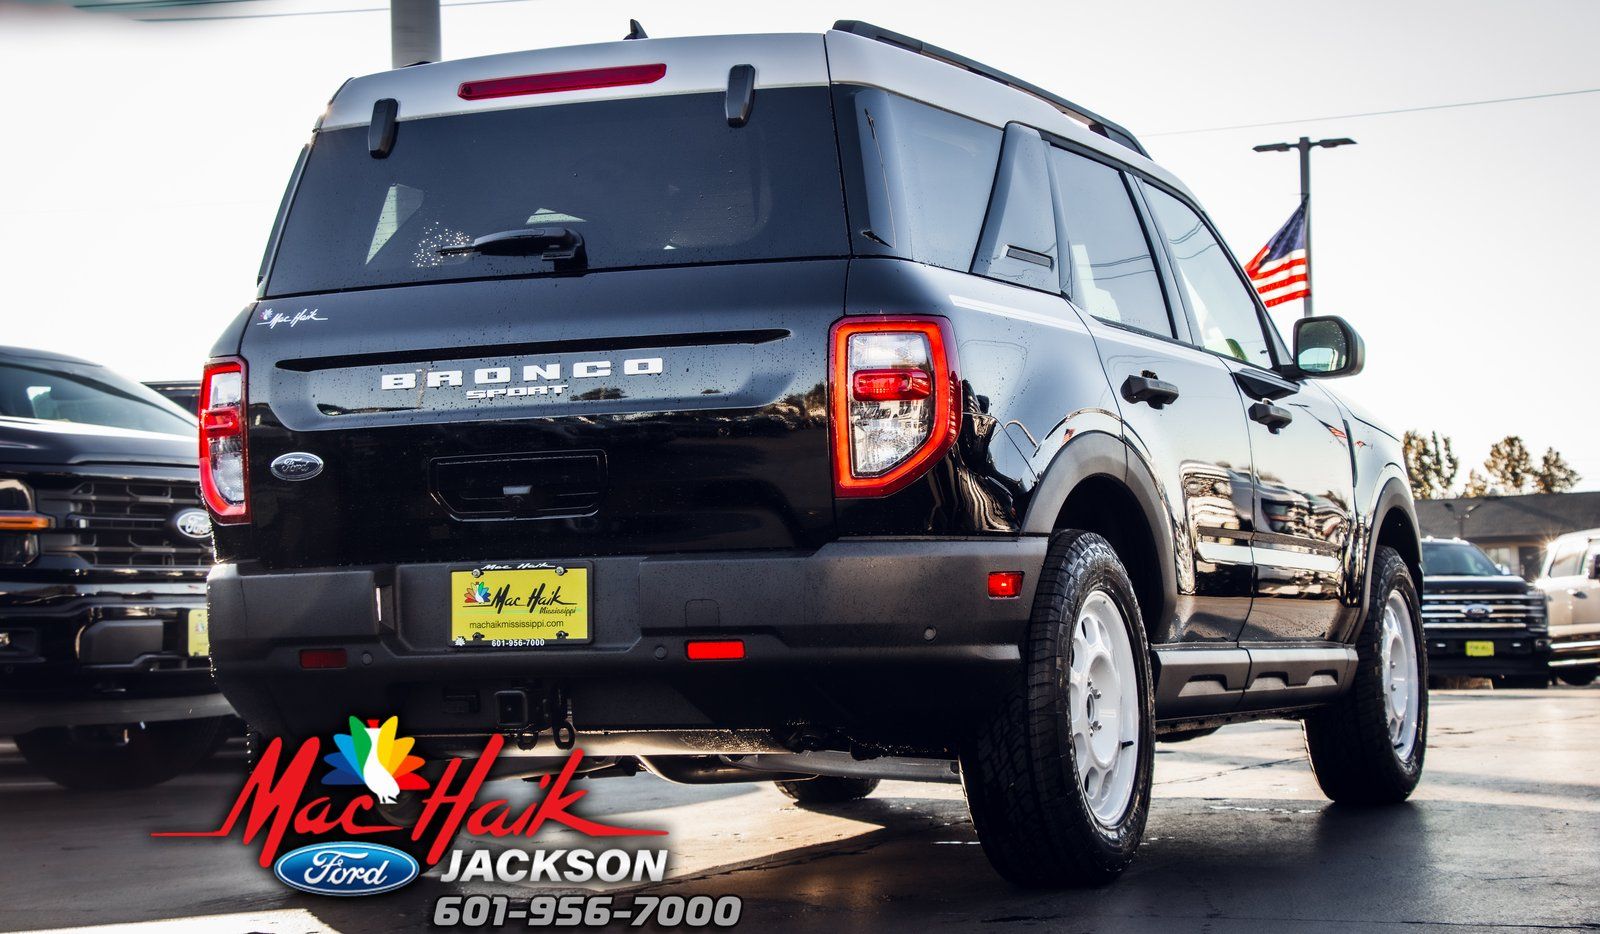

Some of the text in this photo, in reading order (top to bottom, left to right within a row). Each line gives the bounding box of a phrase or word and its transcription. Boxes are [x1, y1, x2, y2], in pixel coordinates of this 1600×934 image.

[381, 357, 664, 390] BRONCO
[466, 384, 569, 400] SPORT
[281, 457, 309, 472] Ford
[516, 562, 556, 570] Haik
[462, 582, 577, 614] Mac Haik
[539, 606, 577, 616] Mississippi
[469, 620, 564, 630] machaikmississippi.com
[491, 639, 545, 647] 601-956-7000
